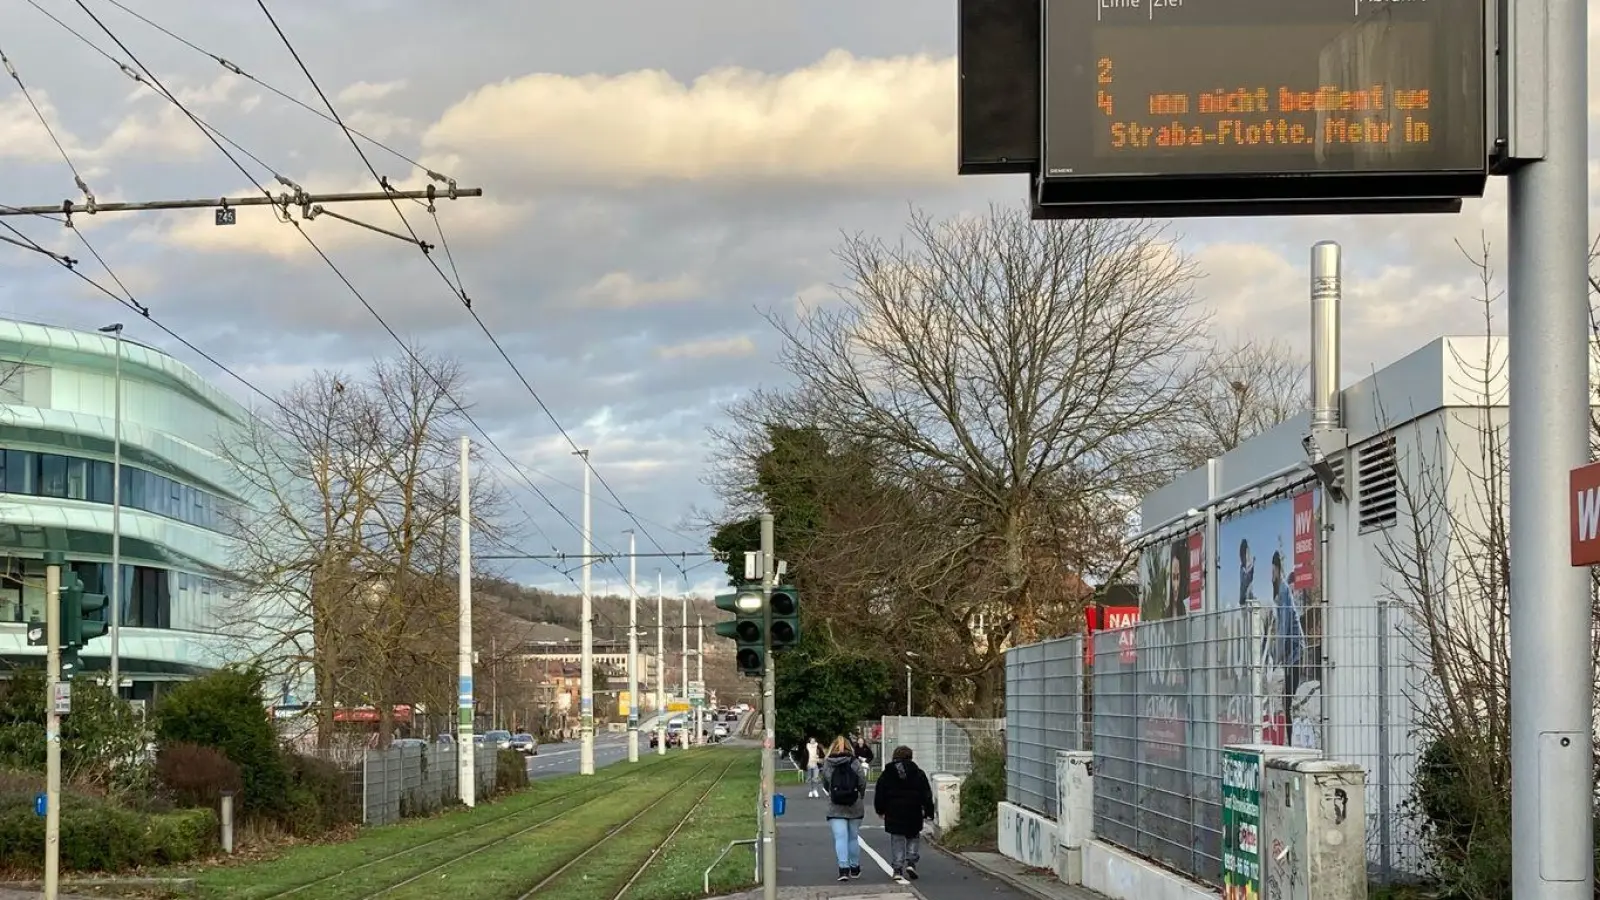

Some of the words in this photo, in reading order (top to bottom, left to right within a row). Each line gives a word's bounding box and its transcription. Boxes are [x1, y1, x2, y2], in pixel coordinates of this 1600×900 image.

[1097, 57, 1112, 83] 2
[1097, 90, 1112, 115] 4
[1199, 87, 1268, 113] nicht
[1279, 86, 1384, 111] bedient
[1110, 119, 1313, 147] Straba-Flotte.
[1325, 117, 1393, 144] Mehr
[1405, 116, 1430, 143] in
